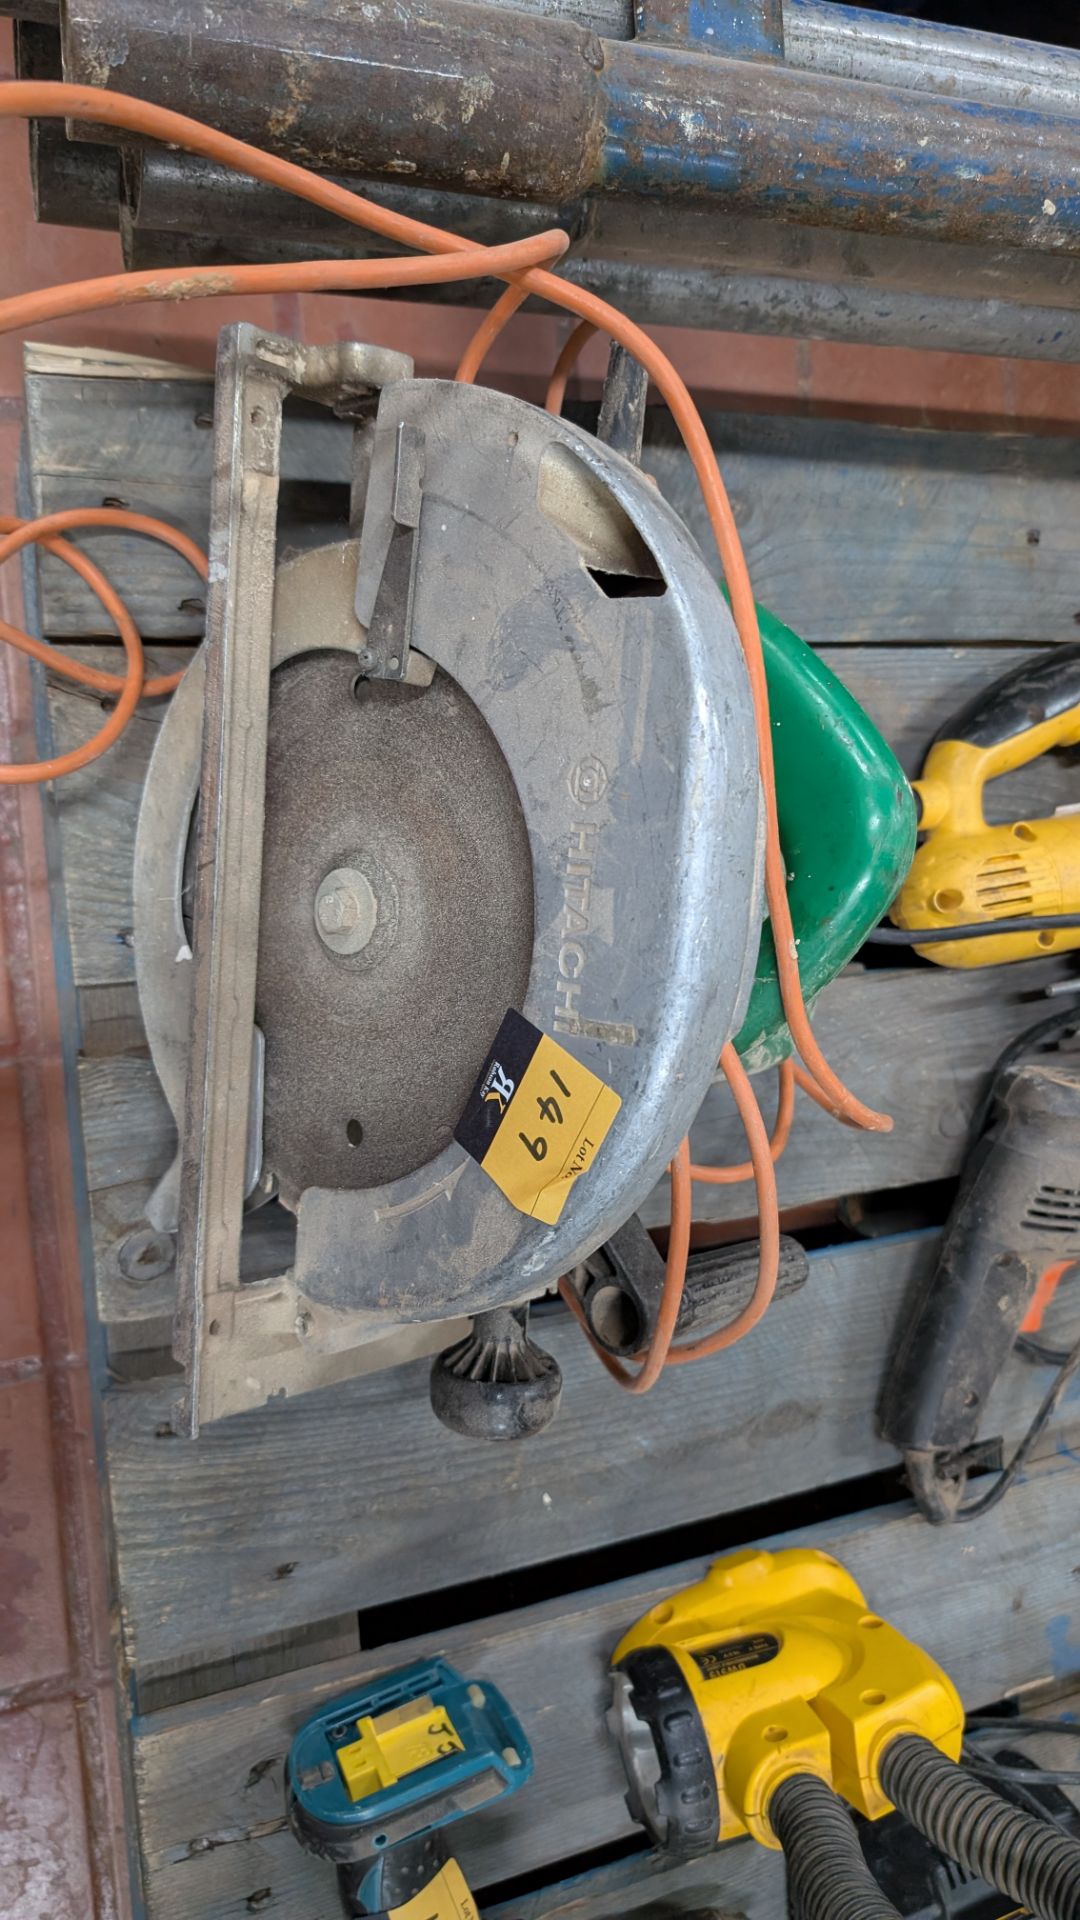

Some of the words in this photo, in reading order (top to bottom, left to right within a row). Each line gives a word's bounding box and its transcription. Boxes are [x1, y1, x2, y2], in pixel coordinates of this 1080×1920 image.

[553, 821, 597, 1035] HITACHI
[518, 1069, 571, 1162] 149
[561, 1160, 583, 1180] No.
[576, 1137, 594, 1162] Lot
